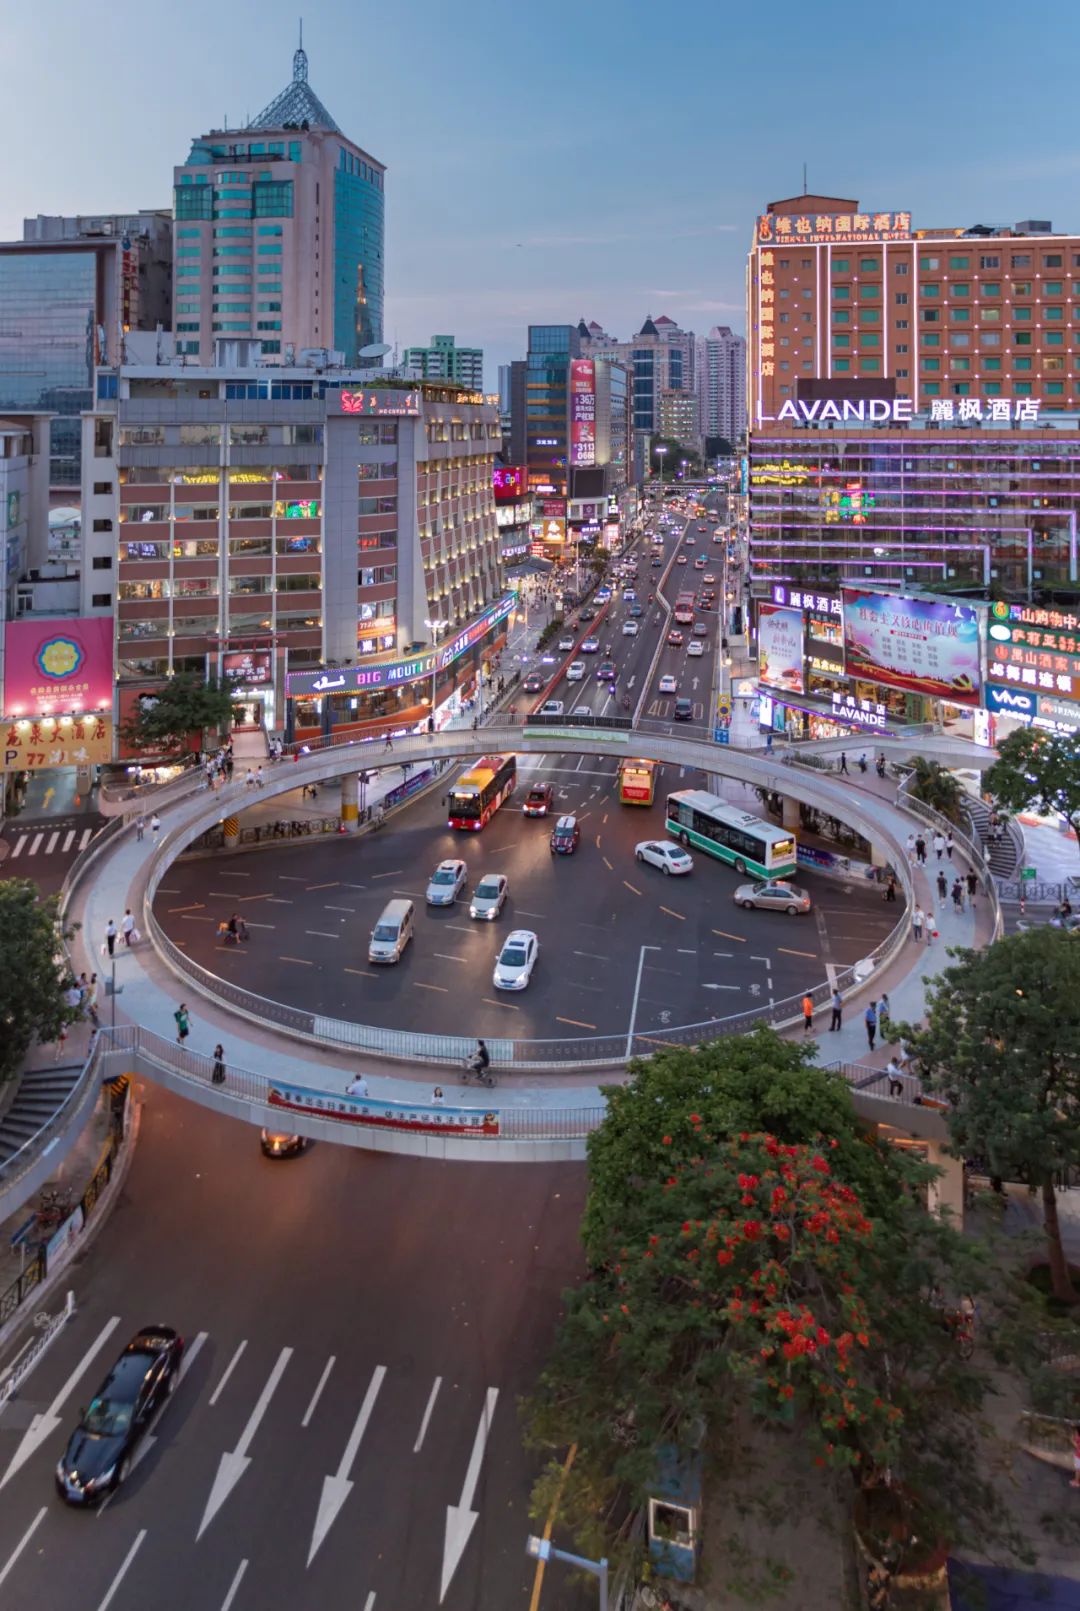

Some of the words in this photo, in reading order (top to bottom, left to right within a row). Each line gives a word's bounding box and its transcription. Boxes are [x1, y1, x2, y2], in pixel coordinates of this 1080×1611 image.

[775, 213, 911, 234] 维也纳国际酒店
[756, 399, 913, 421] LAVANDE
[357, 671, 382, 685] BIG
[832, 704, 886, 728] LAVANDE
[5, 750, 18, 765] P
